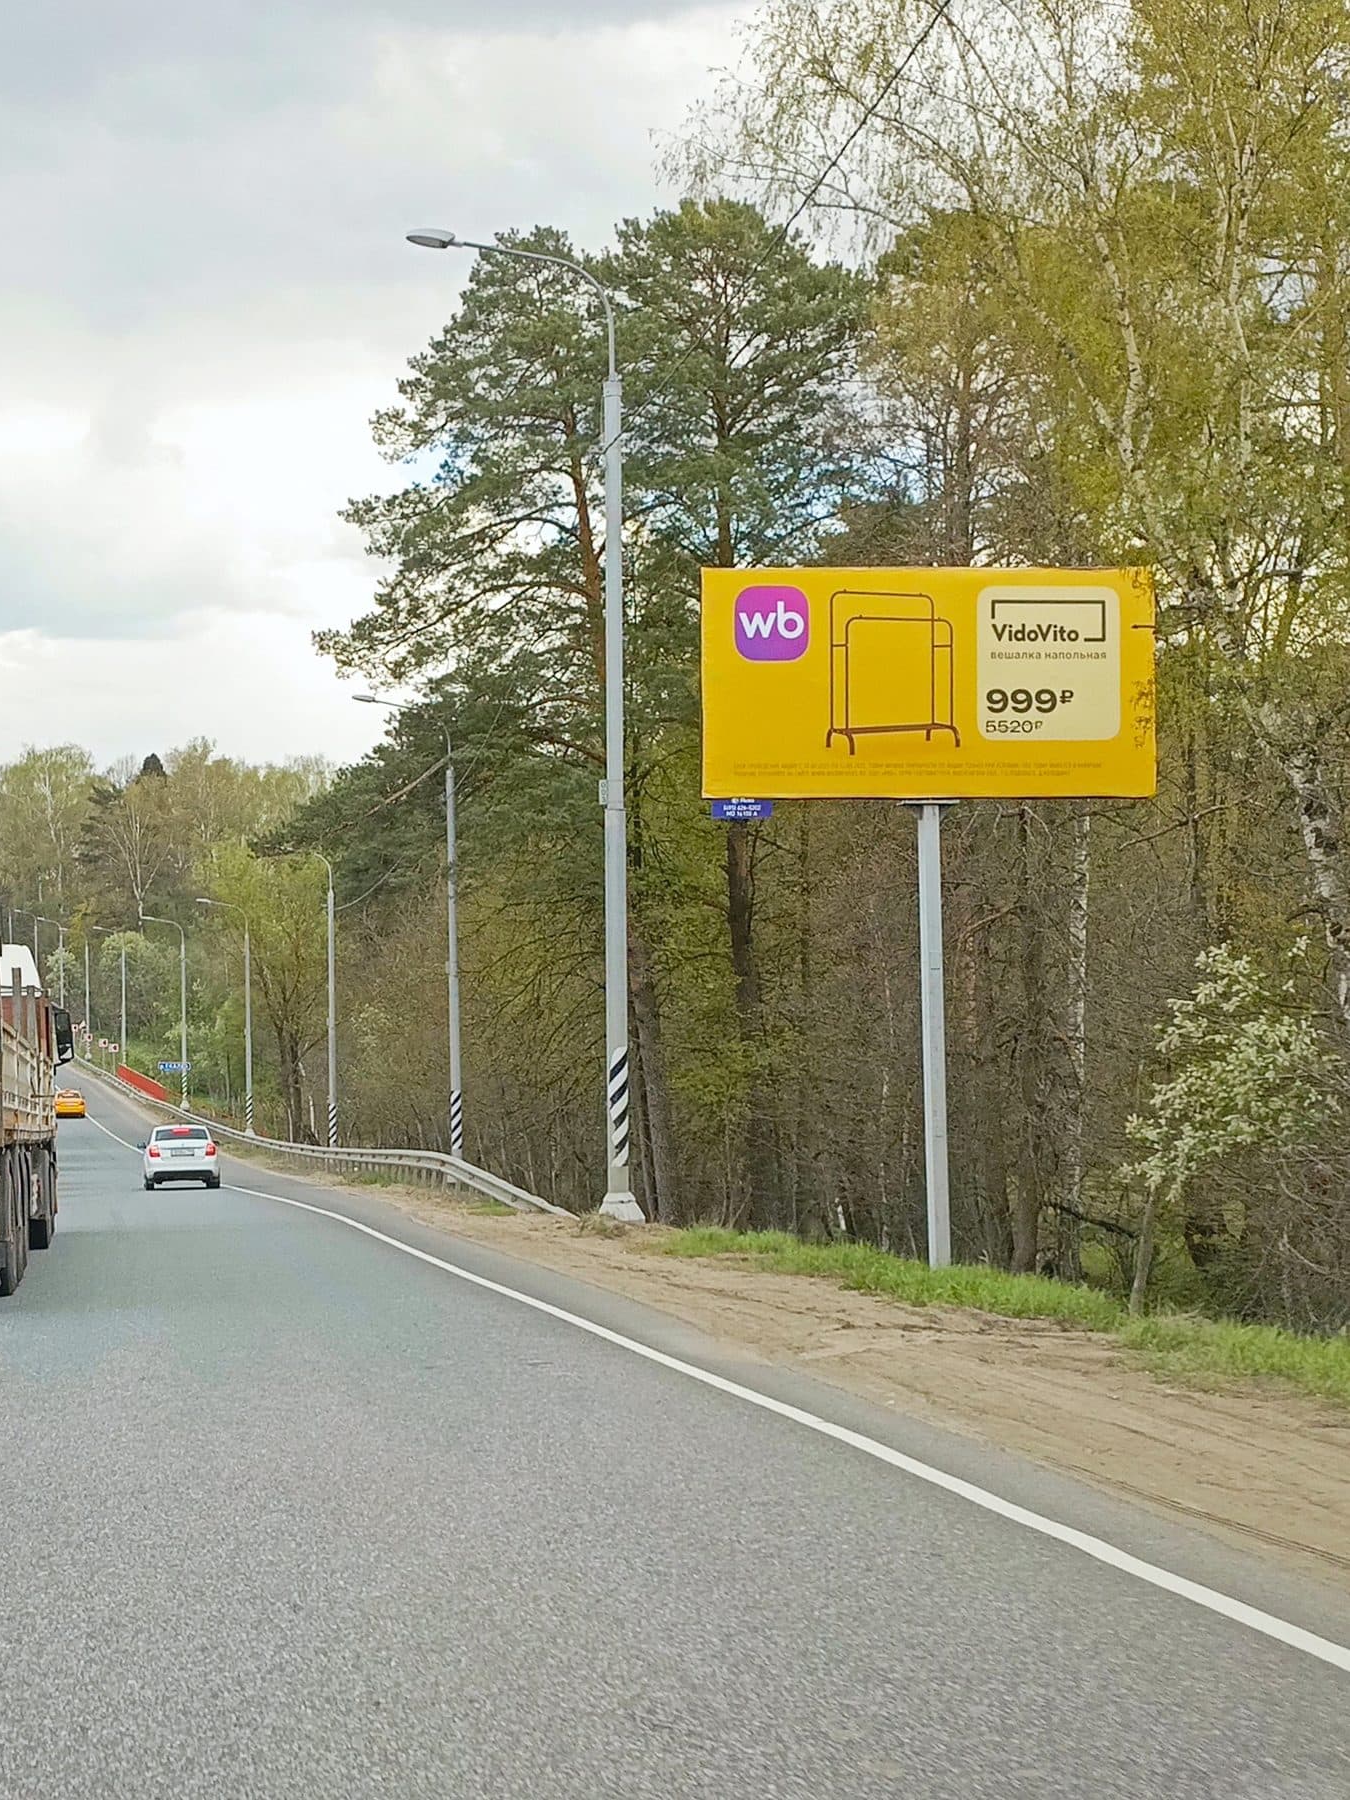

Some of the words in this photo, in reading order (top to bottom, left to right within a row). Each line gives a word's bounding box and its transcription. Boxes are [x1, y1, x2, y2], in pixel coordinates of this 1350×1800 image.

[738, 600, 805, 640] wb
[991, 623, 1080, 642] VidoVito
[990, 651, 1042, 660] вешалка
[1044, 651, 1107, 660] напольная
